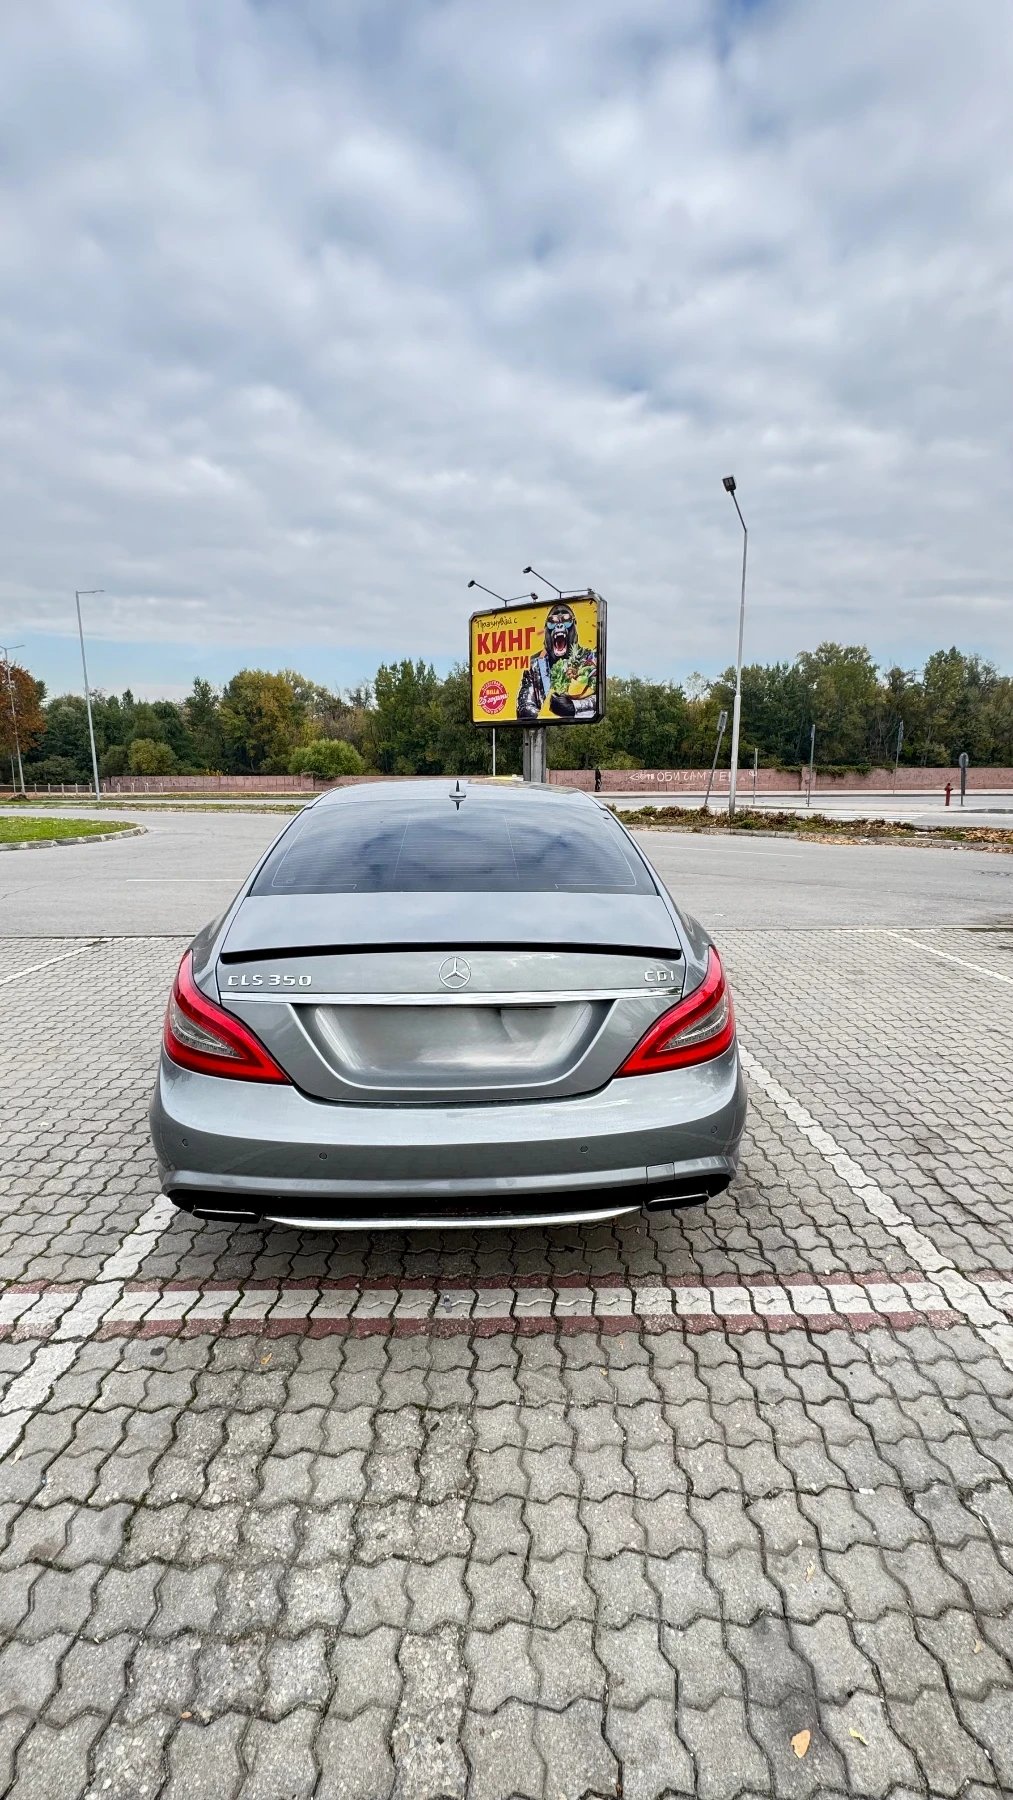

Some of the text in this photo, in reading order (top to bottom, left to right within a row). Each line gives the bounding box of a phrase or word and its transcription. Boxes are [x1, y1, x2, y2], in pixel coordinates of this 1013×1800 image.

[477, 626, 536, 655] КИНГ
[477, 655, 529, 673] ОФЕРТИ
[656, 771, 706, 782] ОБИЧАМ
[227, 974, 313, 987] CLS 350
[644, 970, 676, 982] CDI
